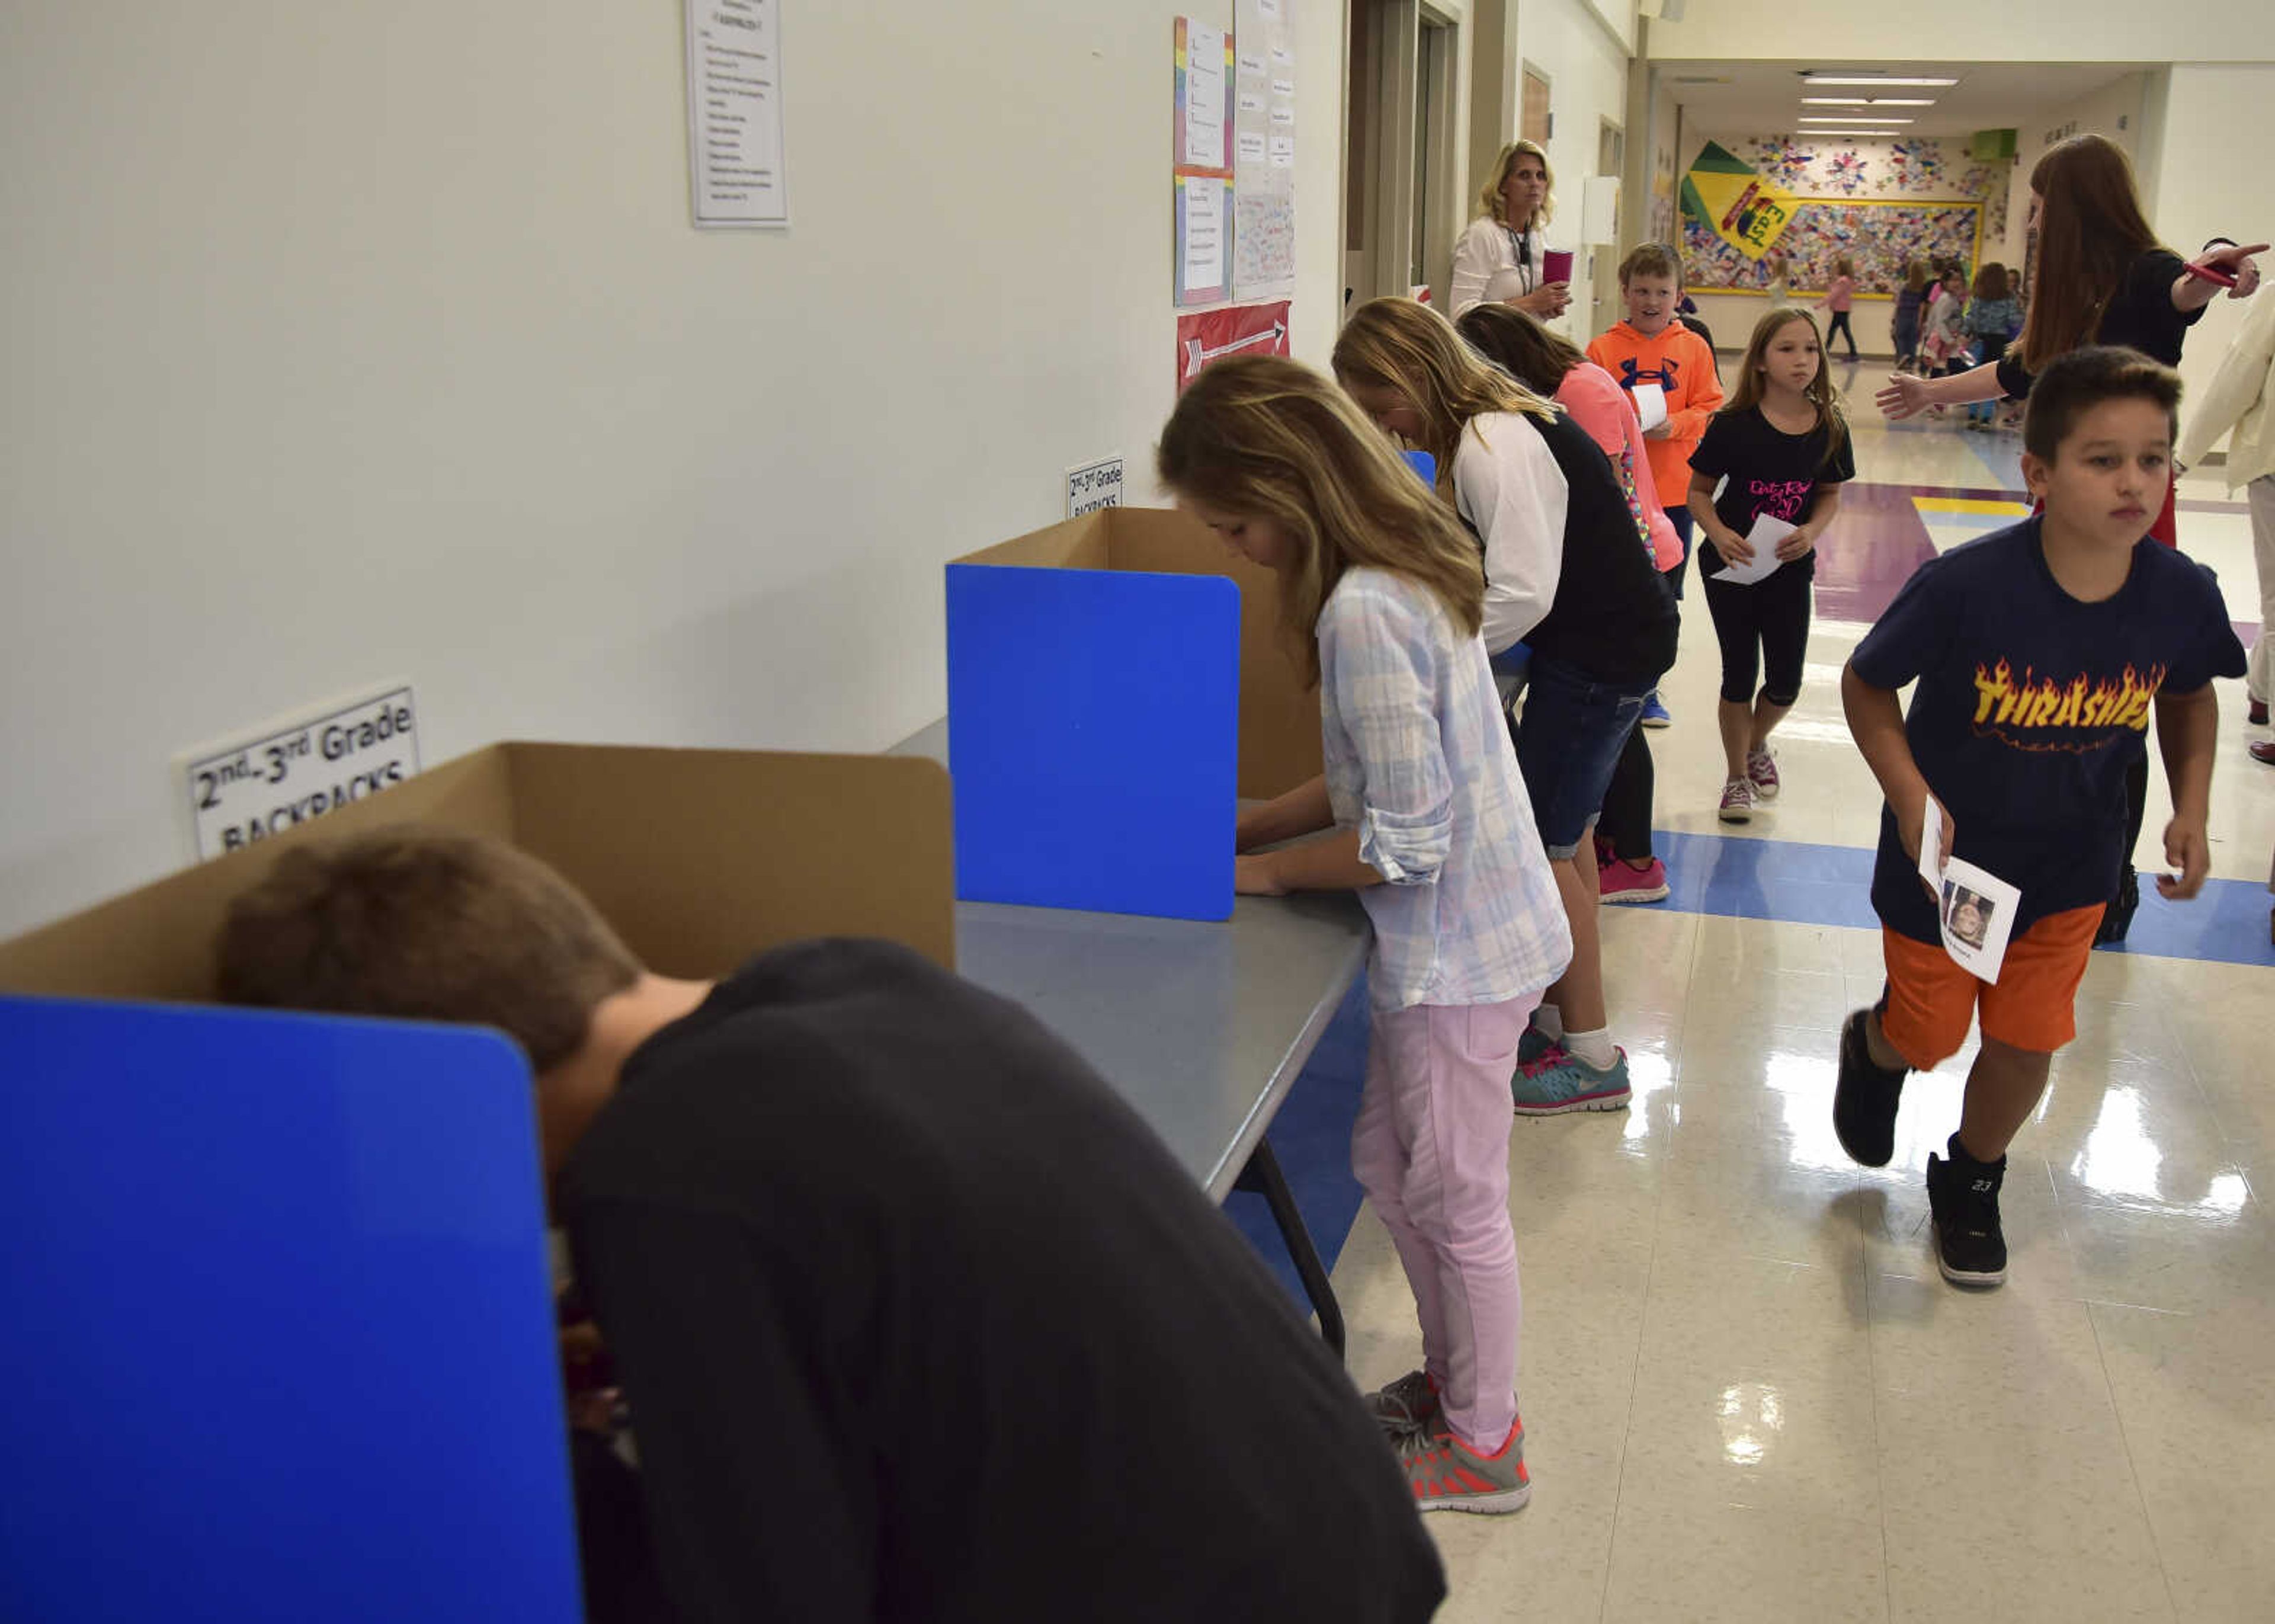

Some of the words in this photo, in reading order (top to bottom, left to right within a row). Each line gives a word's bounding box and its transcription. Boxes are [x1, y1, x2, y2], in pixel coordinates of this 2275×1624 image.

[1745, 204, 1785, 248] East
[1097, 466, 1122, 487] Grade
[1973, 655, 2160, 731] THRASHE
[321, 703, 411, 761] Grade
